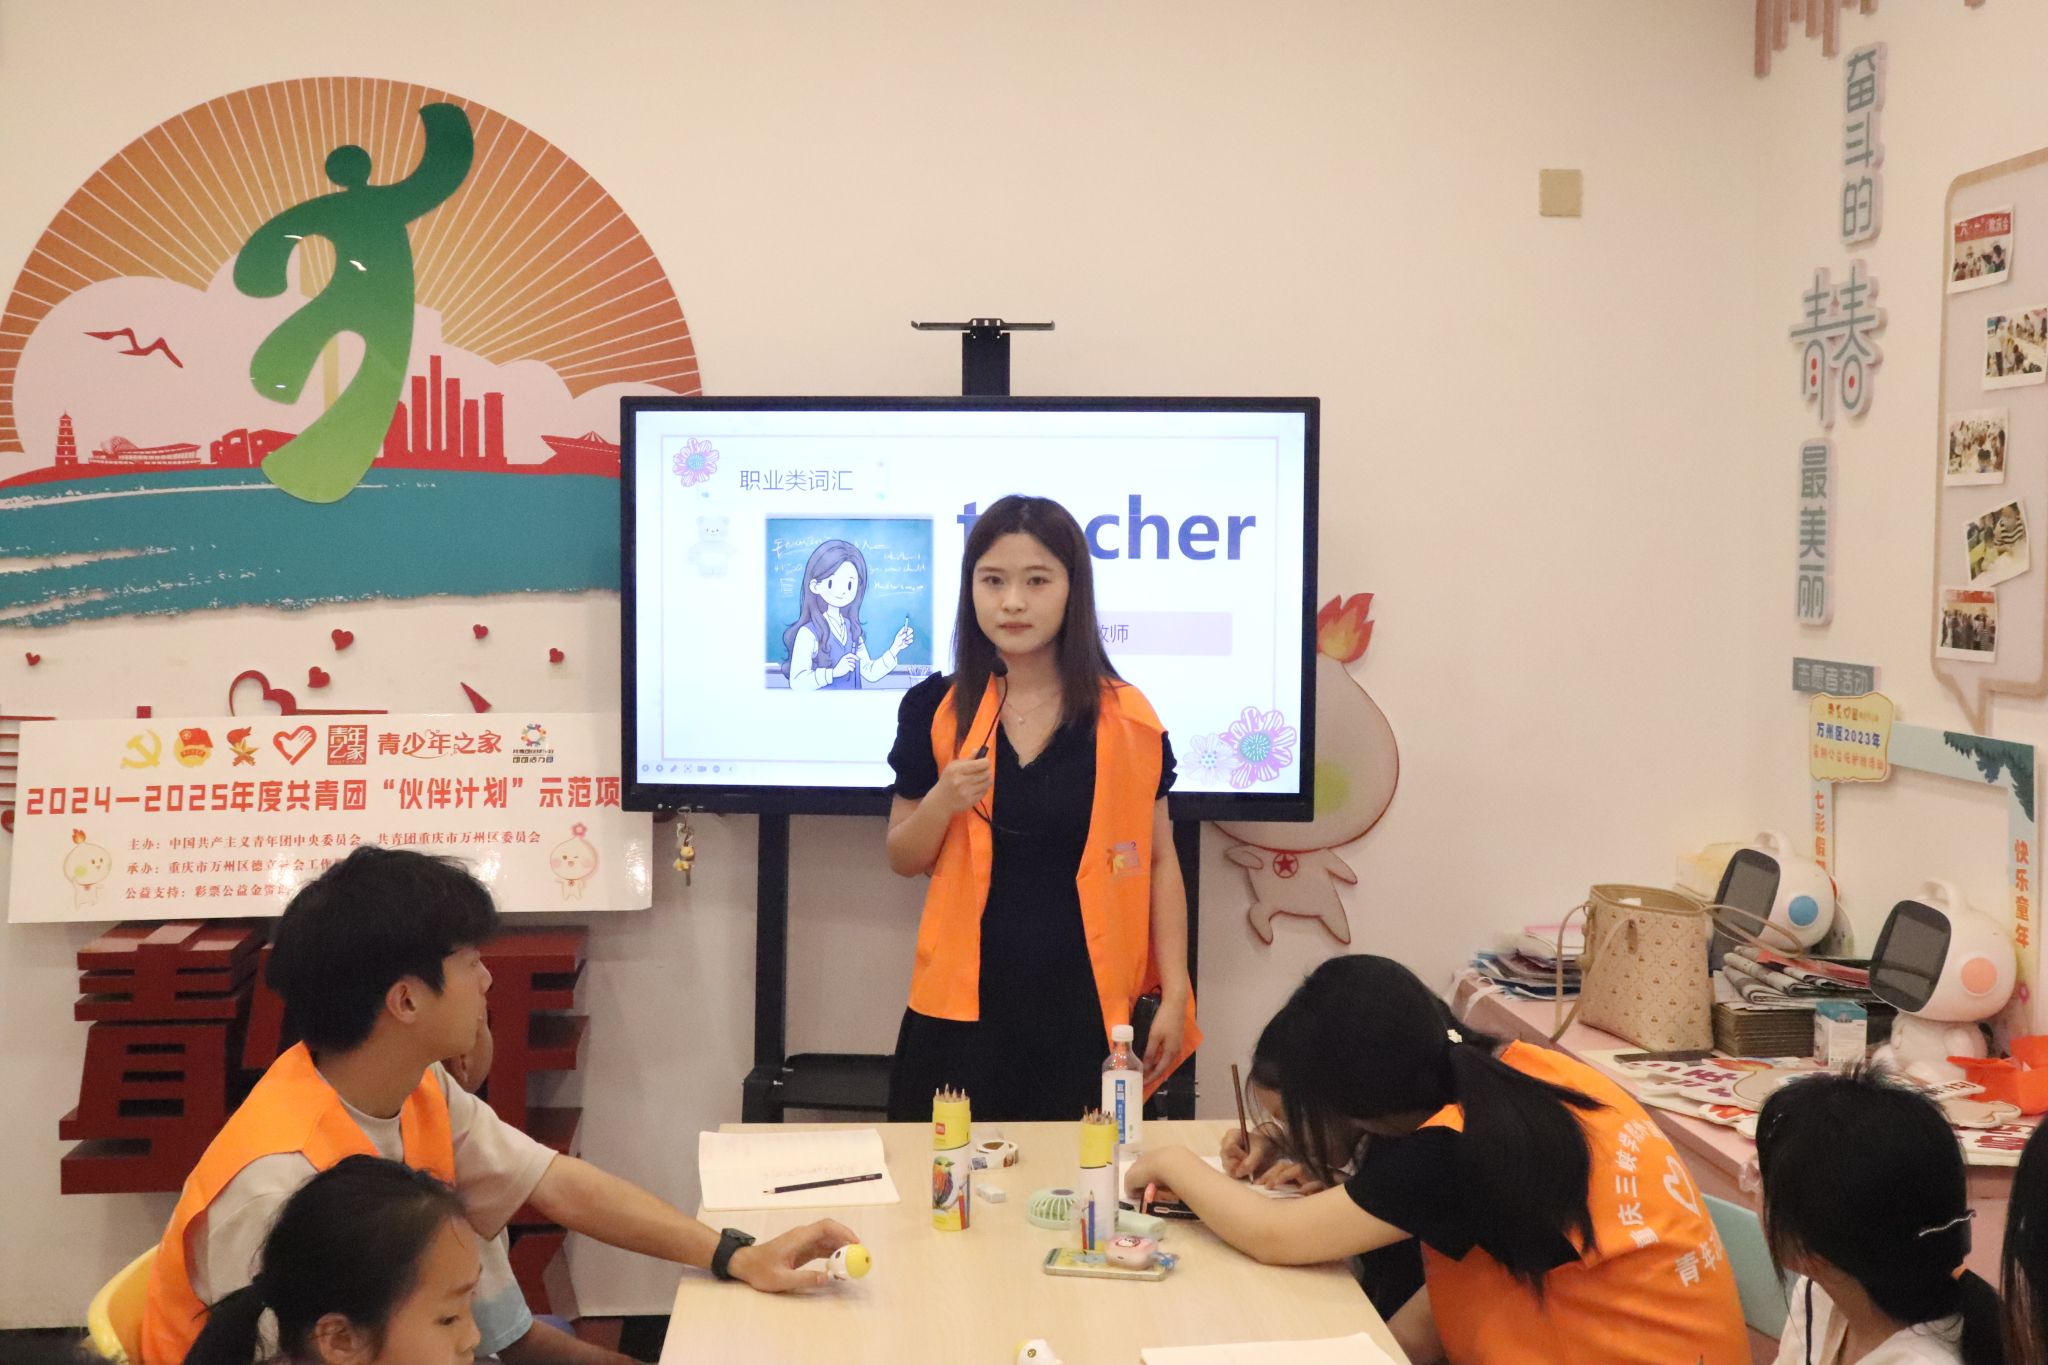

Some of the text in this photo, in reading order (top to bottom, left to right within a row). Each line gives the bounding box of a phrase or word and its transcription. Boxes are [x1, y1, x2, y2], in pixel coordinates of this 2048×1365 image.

[1843, 49, 1877, 237] 奋斗的
[740, 469, 853, 491] 职业类词汇
[957, 495, 1256, 560] tcher
[1797, 445, 1828, 618] 最美丽
[378, 730, 502, 758] 青少年之家
[2015, 840, 2029, 948] 快乐童年
